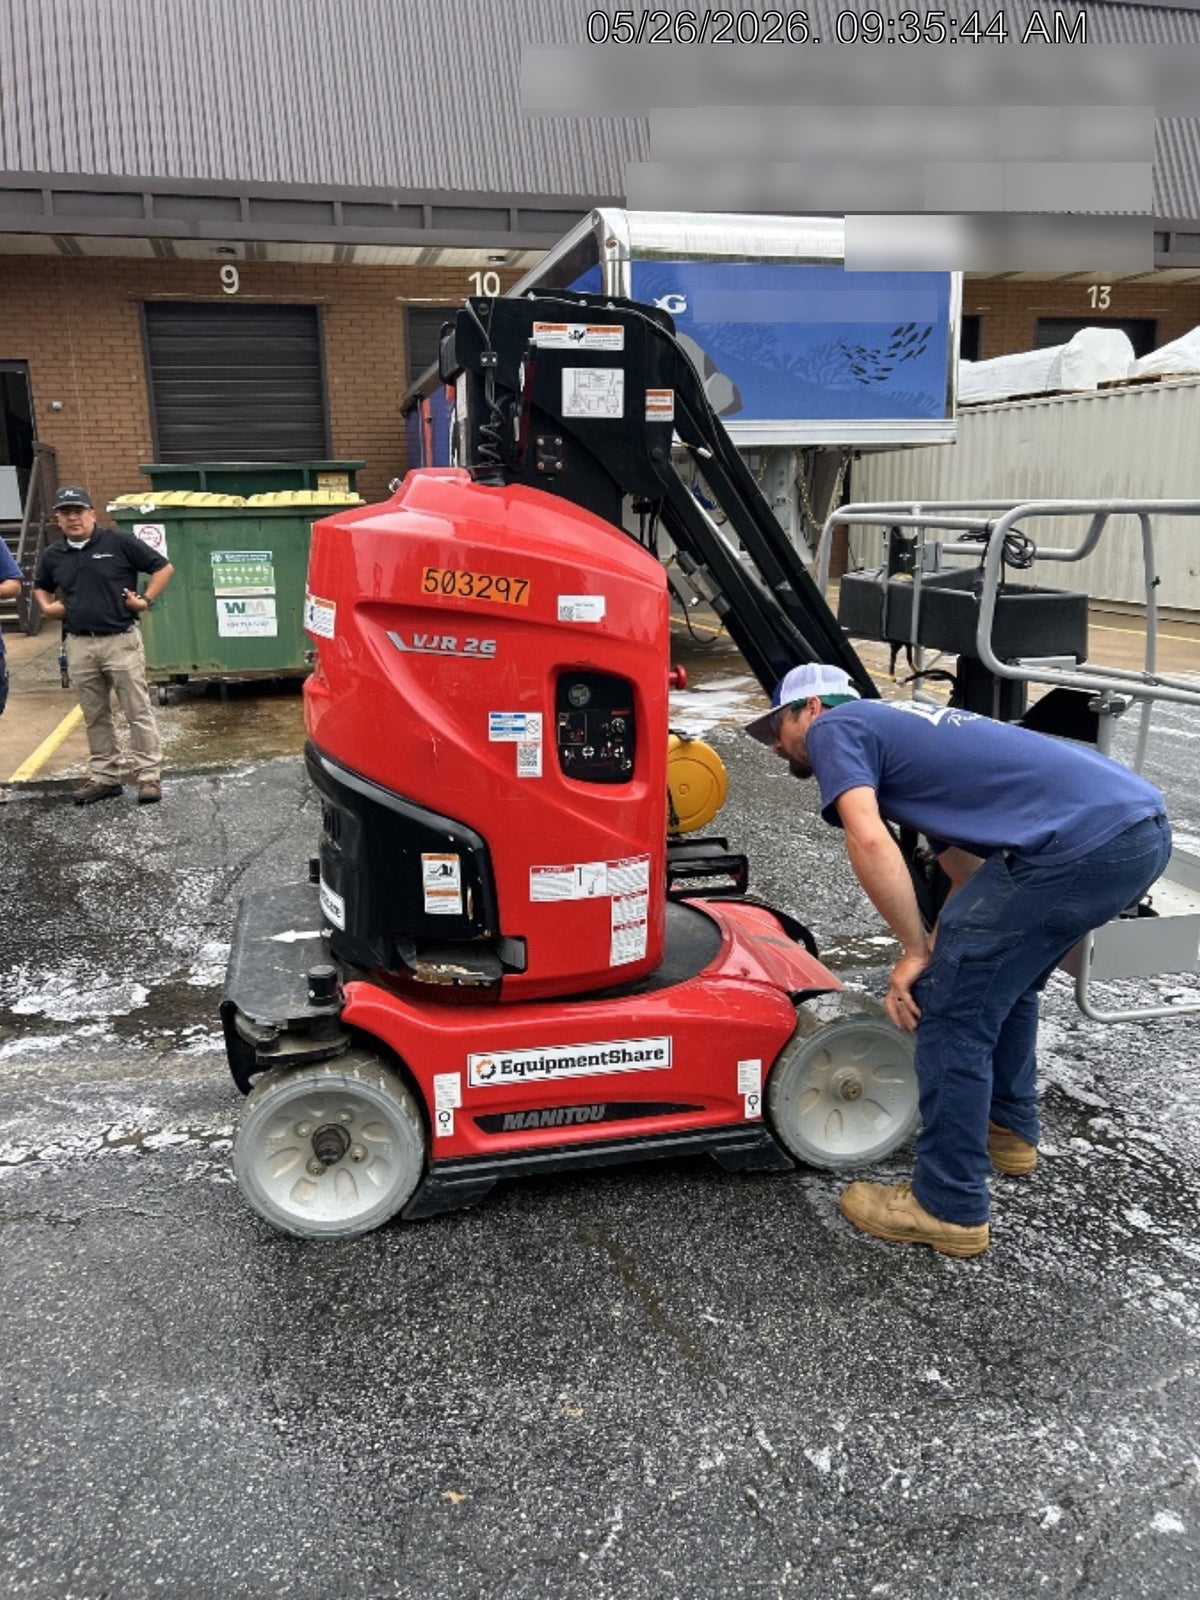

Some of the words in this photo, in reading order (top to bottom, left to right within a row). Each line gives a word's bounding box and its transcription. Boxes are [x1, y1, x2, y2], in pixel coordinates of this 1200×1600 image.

[219, 264, 240, 294] 9
[468, 271, 501, 297] 10
[1087, 284, 1113, 310] 13
[423, 568, 529, 603] 503297
[224, 601, 266, 614] WM
[411, 632, 458, 651] VJR
[463, 637, 497, 654] 26
[500, 1045, 665, 1076] EquipmentShare
[502, 1104, 606, 1131] MANITOU
